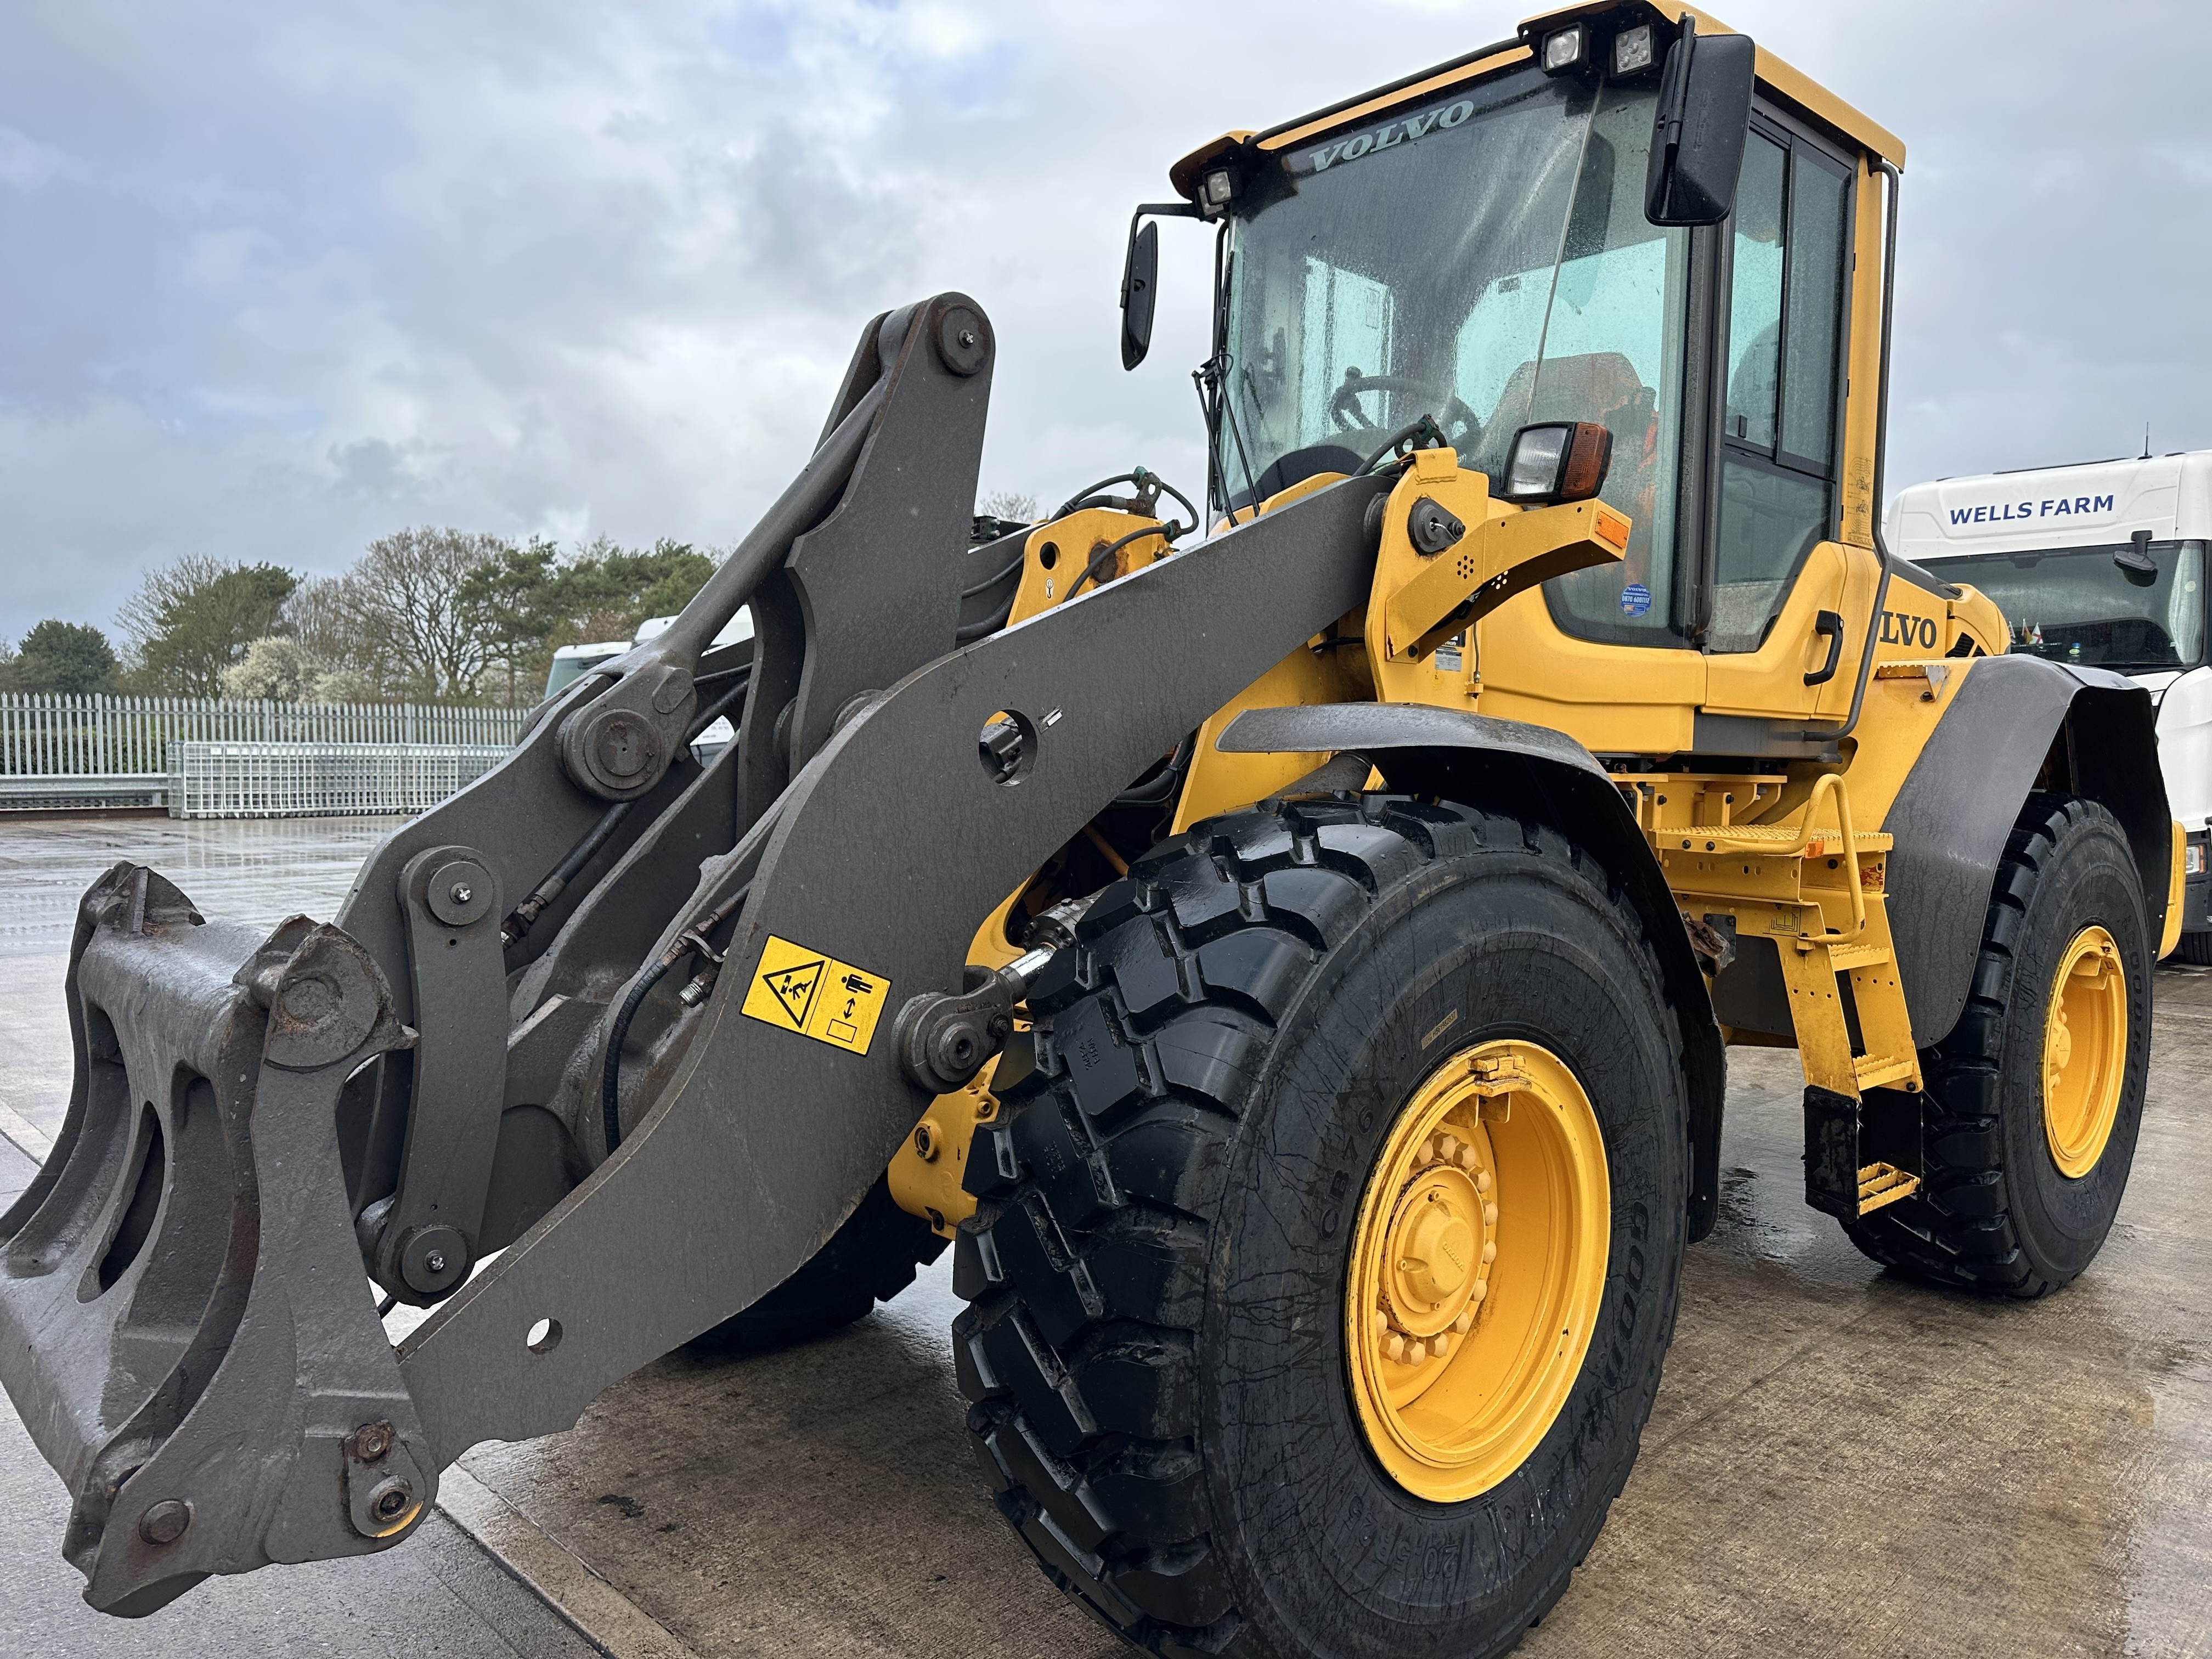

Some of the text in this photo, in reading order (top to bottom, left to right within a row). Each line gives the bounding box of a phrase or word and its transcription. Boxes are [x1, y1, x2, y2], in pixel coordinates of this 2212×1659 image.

[1309, 100, 1474, 172] VOLVO
[1950, 494, 2114, 525] WELLS FARM
[1880, 610, 1937, 649] LVO
